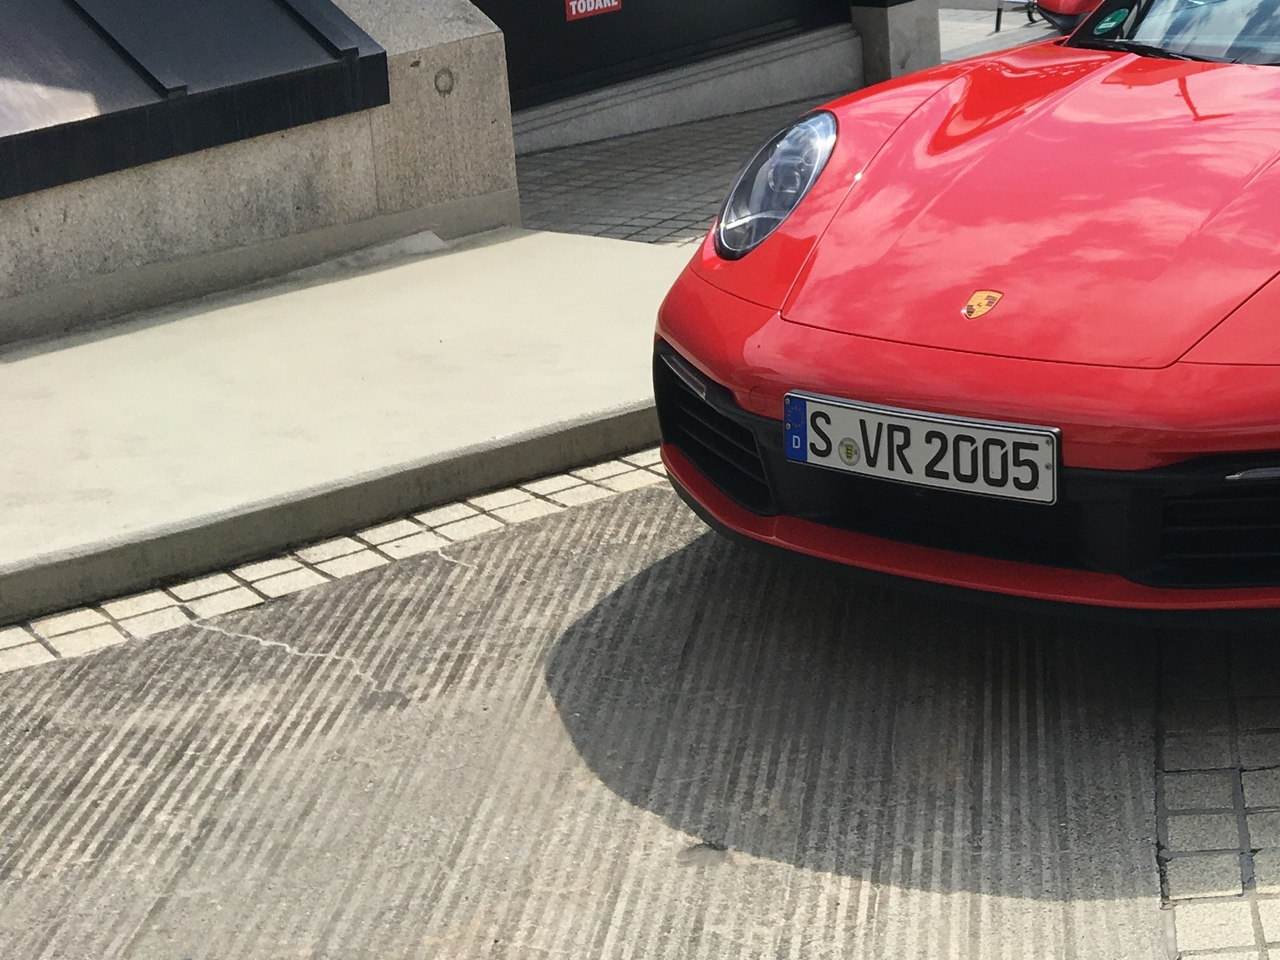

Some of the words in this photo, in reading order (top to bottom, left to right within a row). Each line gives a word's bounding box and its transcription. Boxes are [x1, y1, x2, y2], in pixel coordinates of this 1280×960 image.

[791, 434, 801, 449] D
[809, 410, 833, 458] S
[859, 418, 914, 475] VR
[924, 430, 1040, 492] 2005
